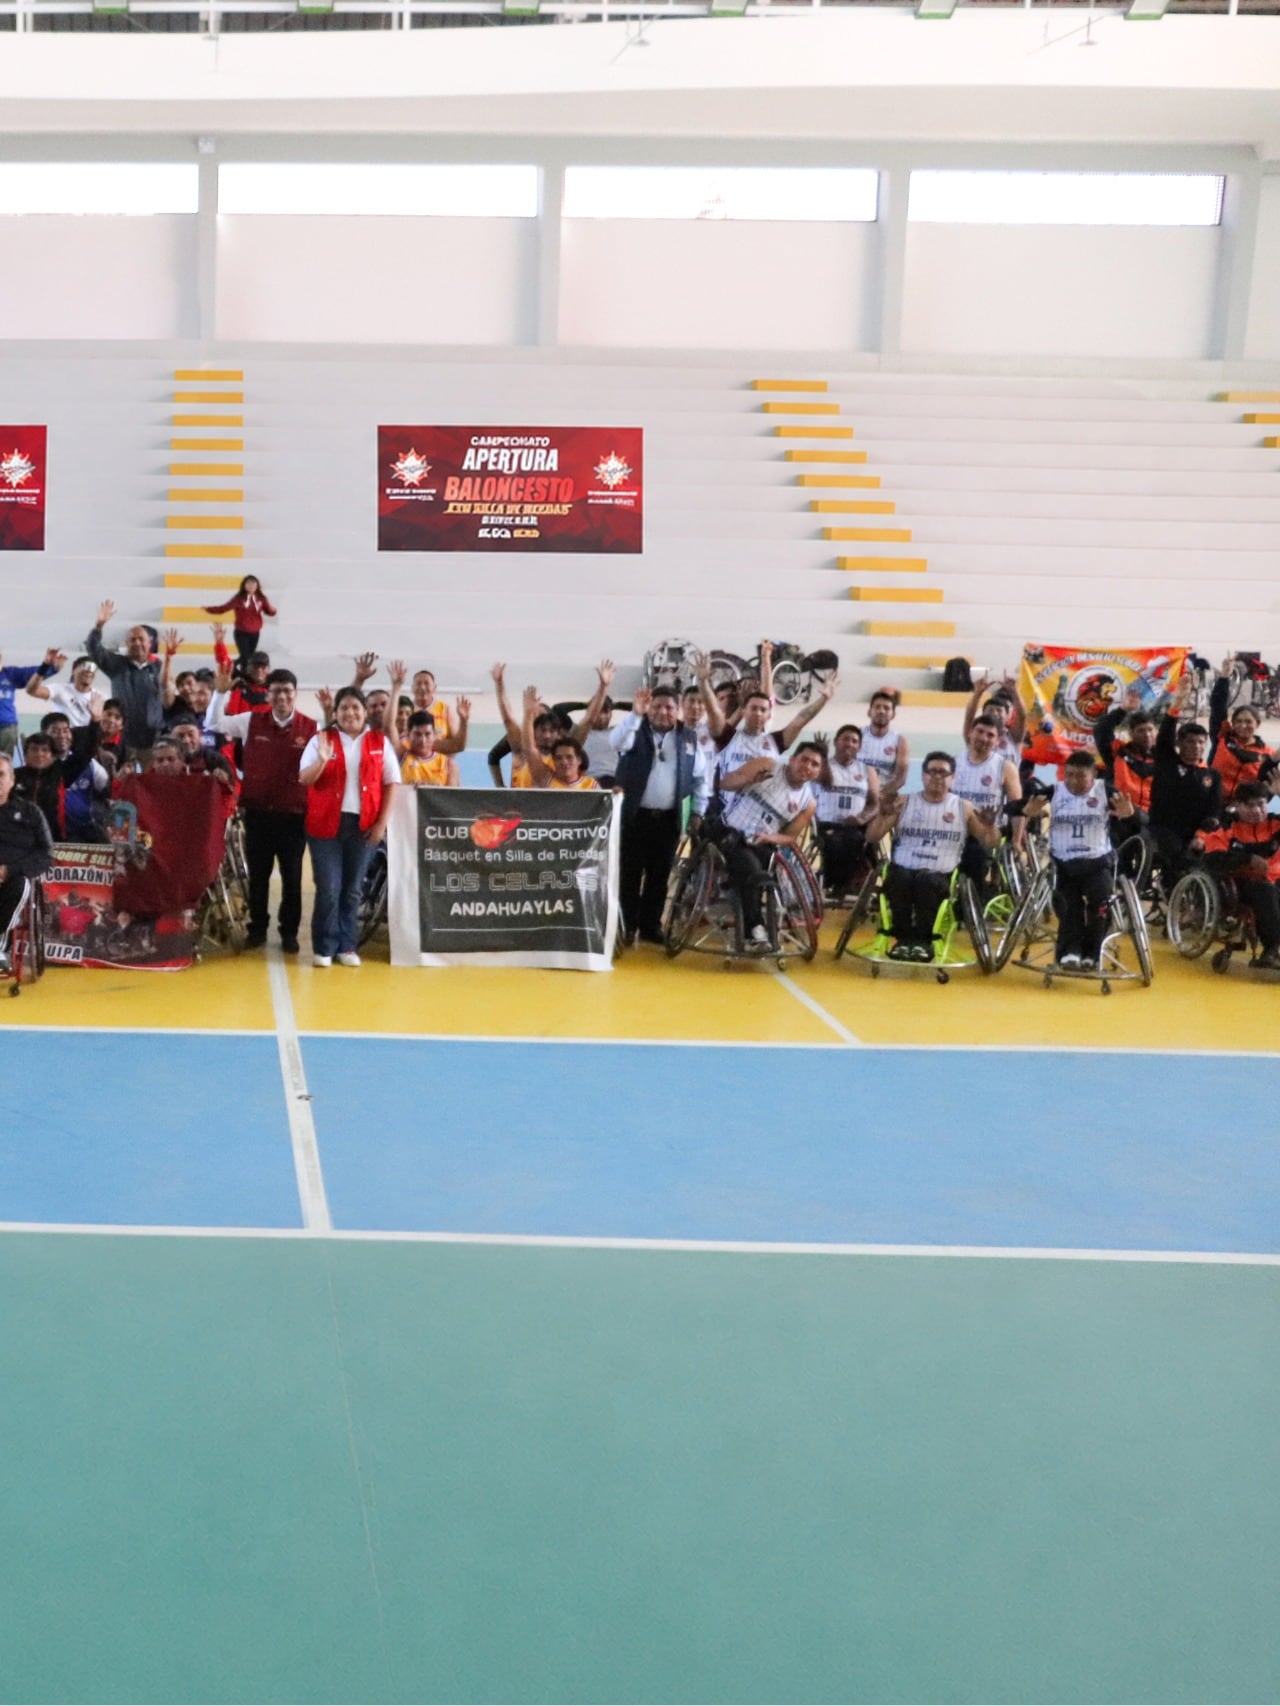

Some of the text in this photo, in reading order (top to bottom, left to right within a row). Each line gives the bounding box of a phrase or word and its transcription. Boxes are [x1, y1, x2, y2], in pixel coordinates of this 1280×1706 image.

[470, 436, 550, 447] CAMPEONATO
[462, 448, 558, 474] APERTURA
[444, 476, 574, 502] BALONCESTO
[425, 826, 608, 841] CLUB DEPORTIVO
[485, 852, 502, 862] en
[506, 850, 532, 862] Silla
[537, 850, 554, 861] de
[559, 848, 604, 861] Ruedas
[46, 865, 104, 883] CORAZÓN
[430, 872, 480, 892] LOS
[450, 899, 574, 916] ANDAHUAYLAS
